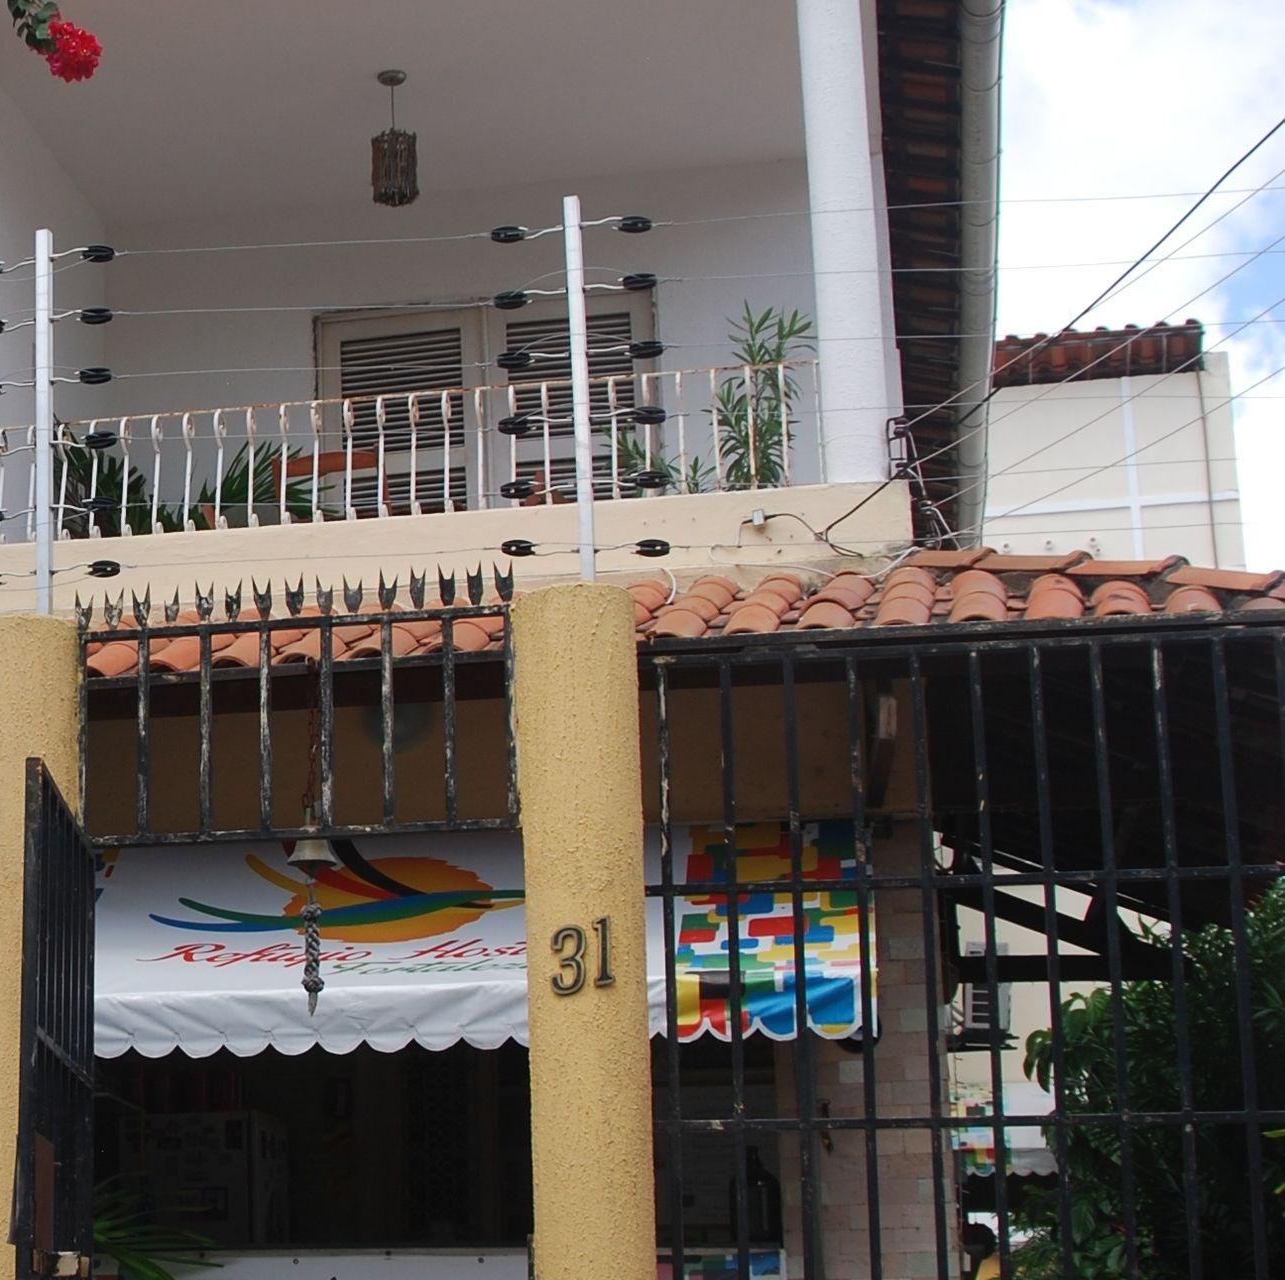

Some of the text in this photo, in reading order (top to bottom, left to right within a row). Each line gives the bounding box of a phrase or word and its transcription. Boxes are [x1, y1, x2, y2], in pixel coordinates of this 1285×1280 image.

[388, 938, 528, 961] Host
[550, 915, 616, 996] 31
[321, 958, 527, 975] Fortalez
